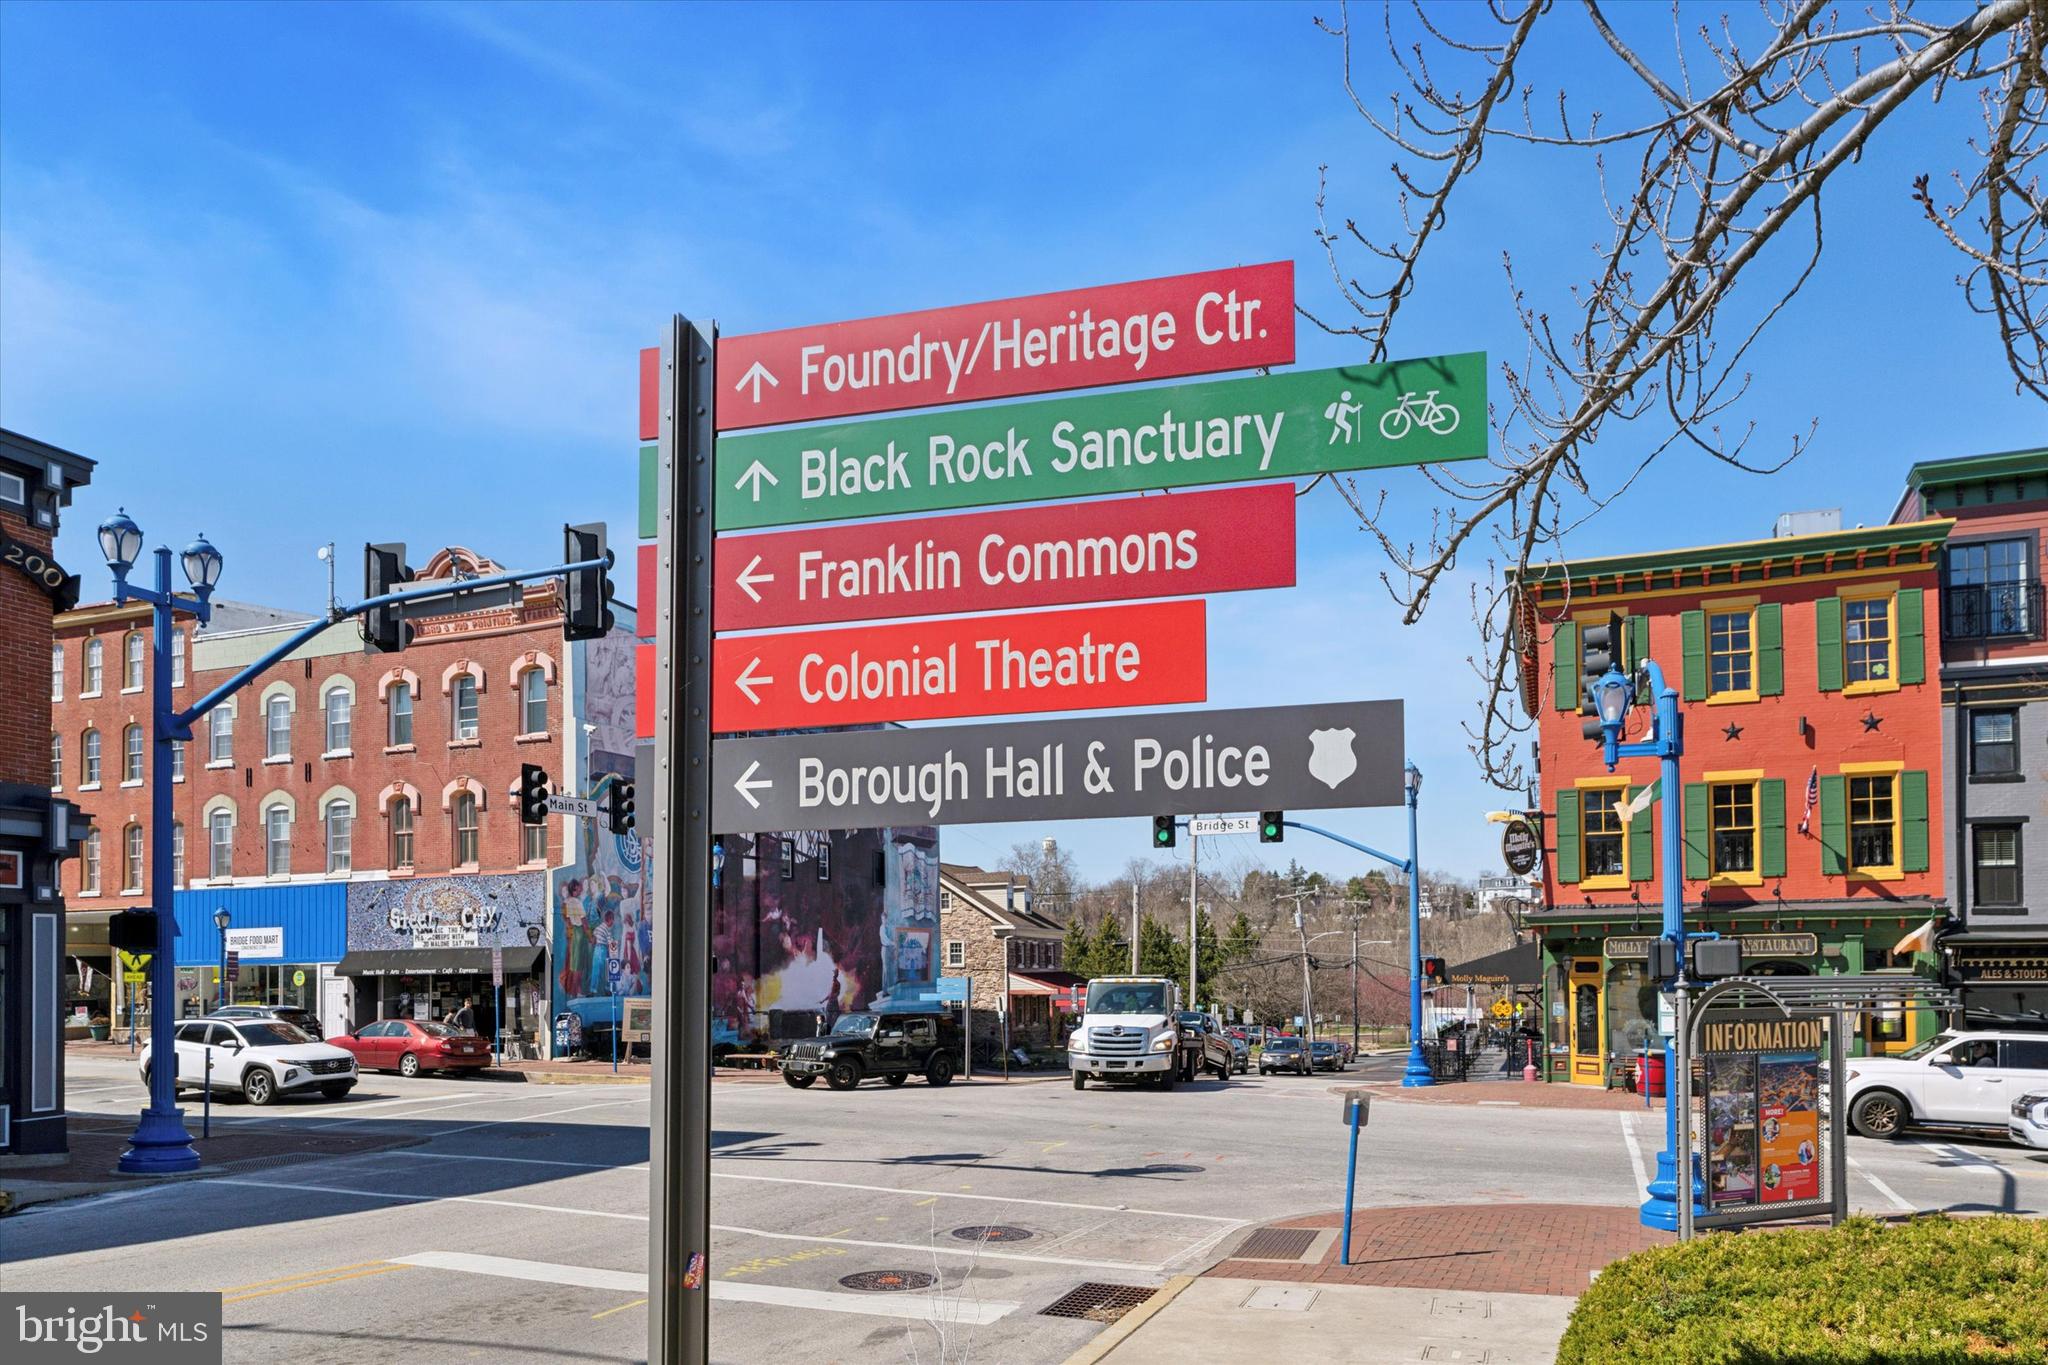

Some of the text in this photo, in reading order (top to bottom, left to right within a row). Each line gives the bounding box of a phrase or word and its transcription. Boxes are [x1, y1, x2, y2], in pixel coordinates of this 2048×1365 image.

[801, 289, 1269, 395] Foundry/Heritage Ctr.
[801, 410, 1284, 499] Black Rock Sanctuary
[4, 544, 63, 587] 200
[799, 529, 1198, 601] Franklin Commons
[799, 632, 1140, 704] Colonial Theatre
[799, 734, 1271, 819] Borough Hall & Police
[549, 798, 588, 813] Main St
[1196, 820, 1249, 832] Bridge St
[389, 905, 498, 930] Steel City
[230, 934, 279, 945] BRIDGE FOOD MART
[1609, 940, 1642, 953] MOLLY
[1740, 938, 1811, 952] RESTAURANT
[1452, 974, 1510, 983] Molly Maguire's
[1980, 969, 2048, 979] ALES & STOUTS
[1705, 1020, 1822, 1052] INFORMATION
